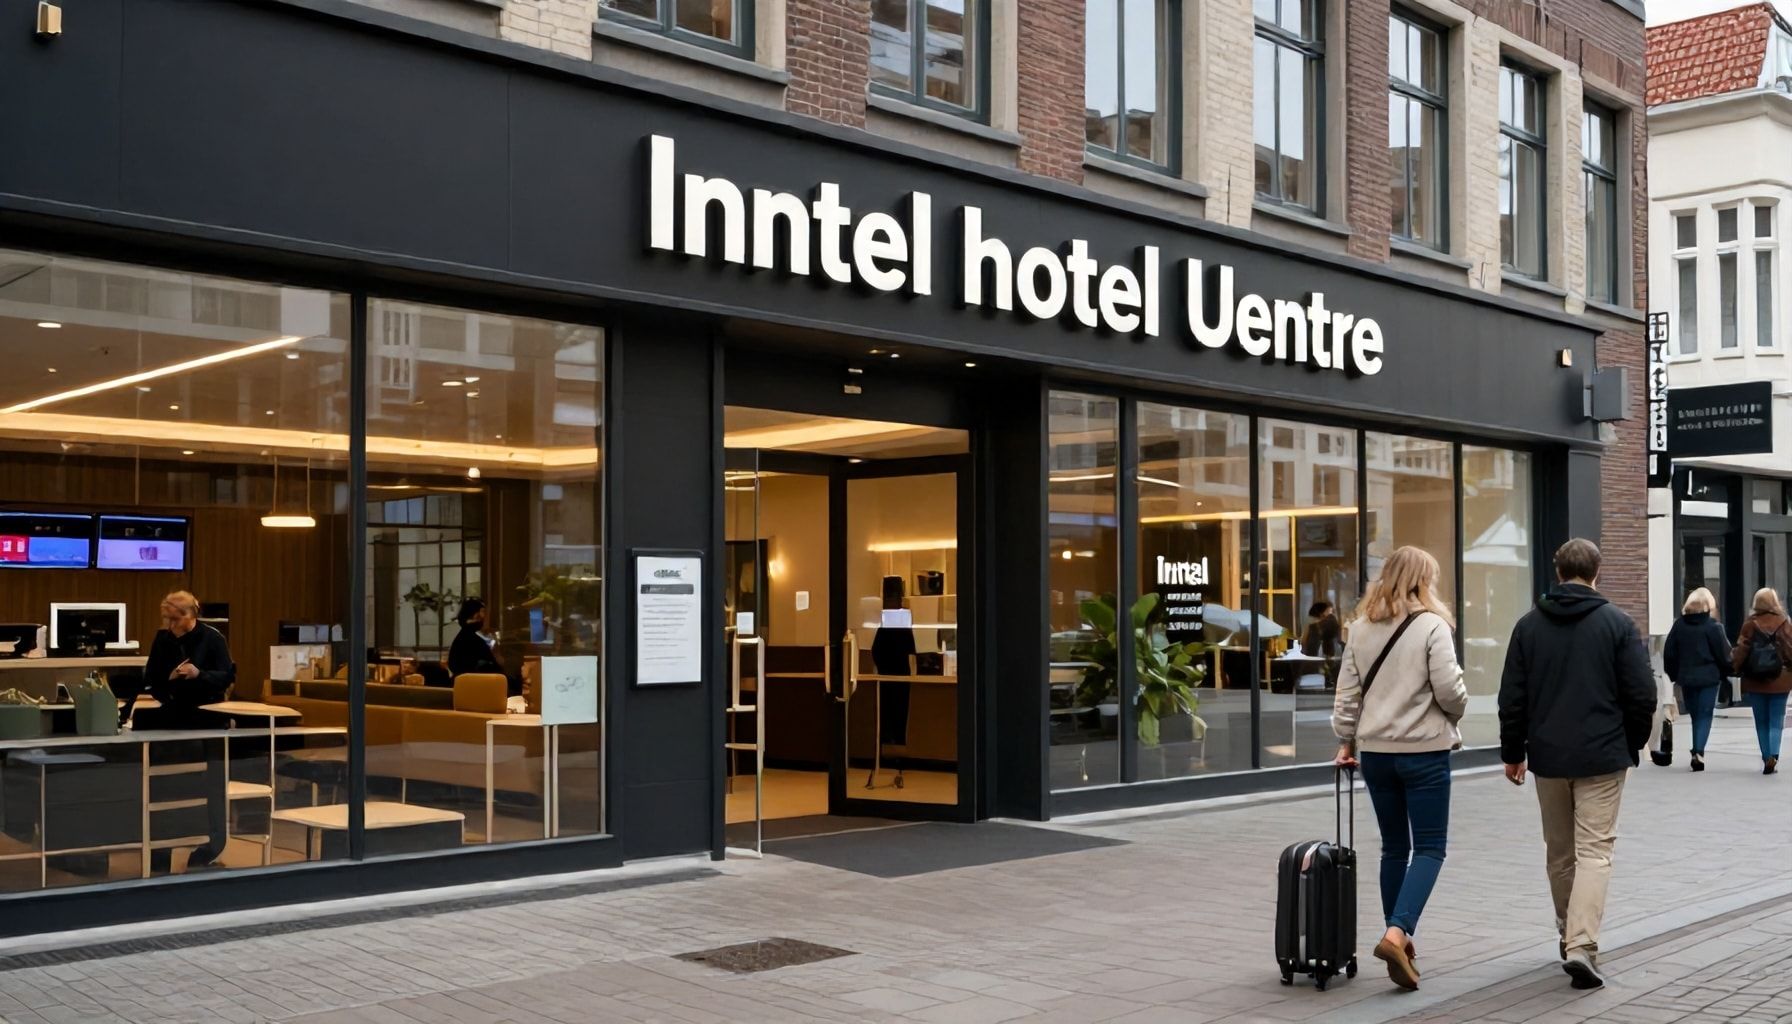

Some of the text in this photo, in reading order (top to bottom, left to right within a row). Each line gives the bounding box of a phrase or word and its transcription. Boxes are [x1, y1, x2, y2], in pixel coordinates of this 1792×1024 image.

[649, 134, 1384, 376] Inntel hotel Uentre
